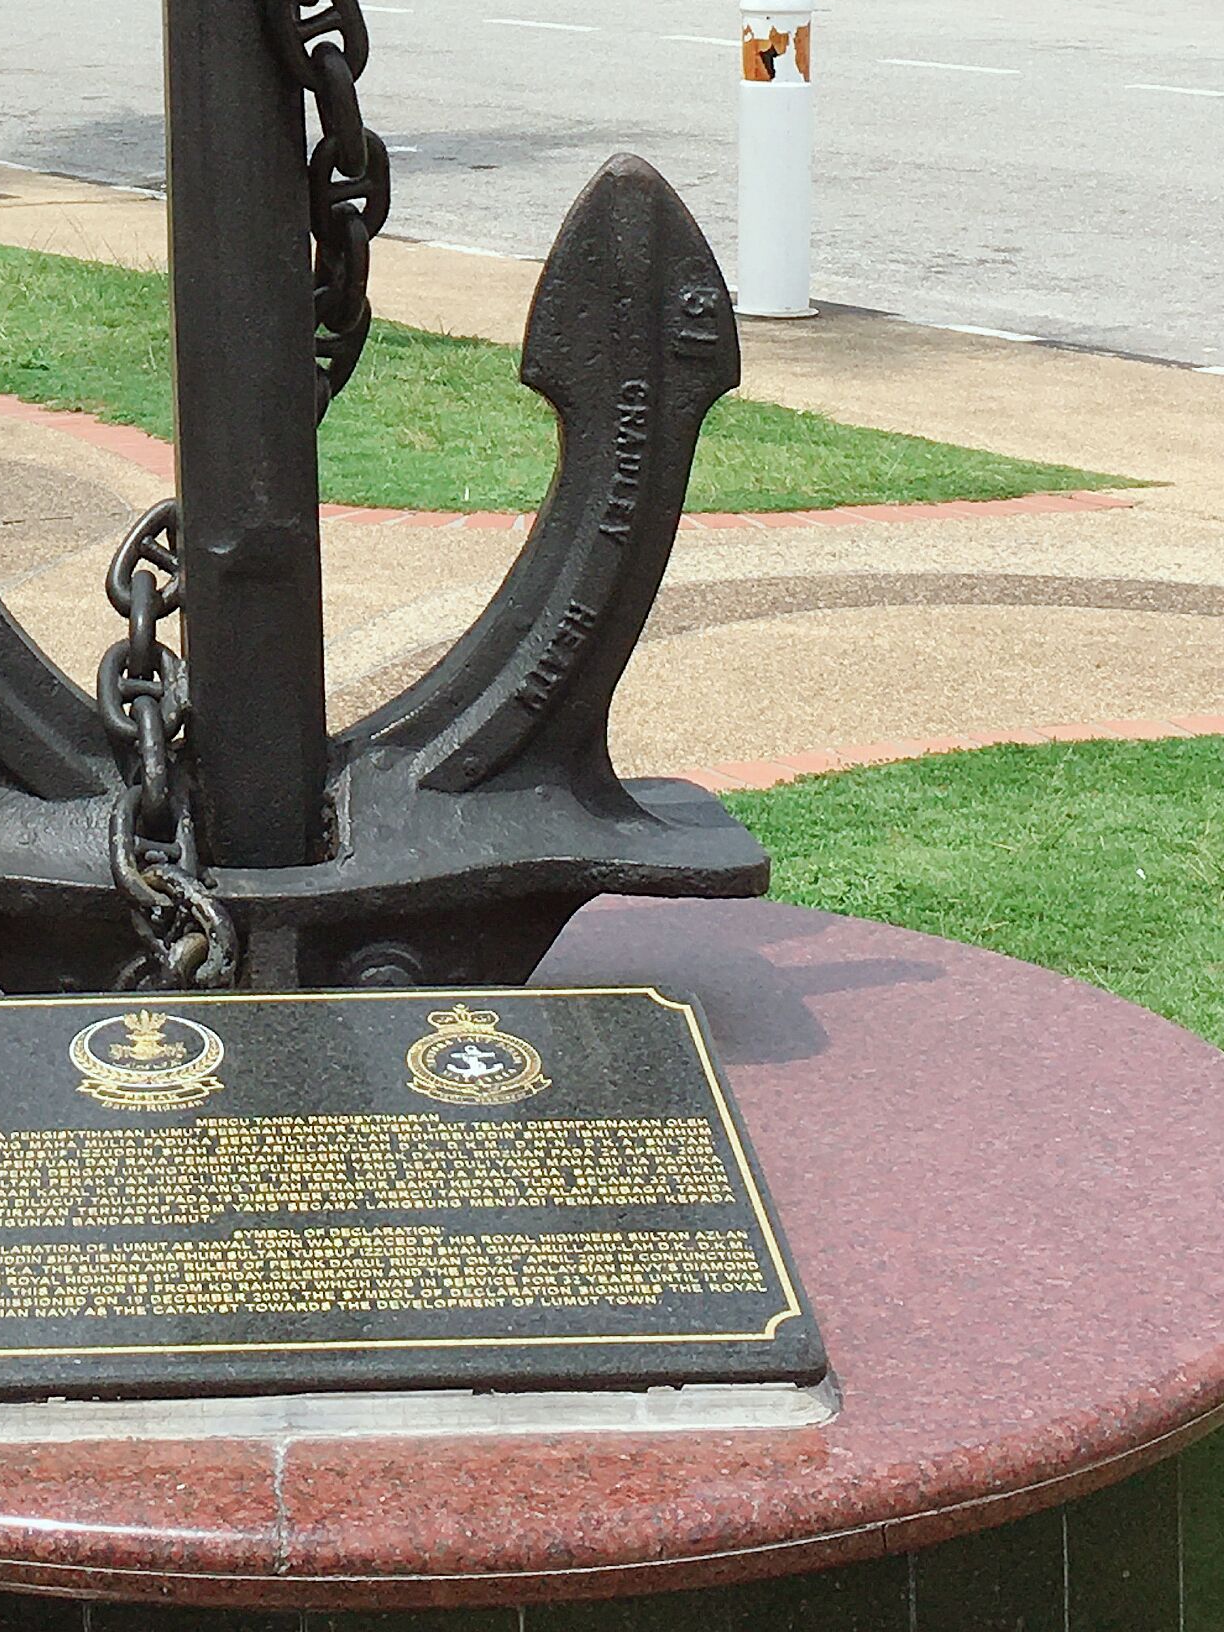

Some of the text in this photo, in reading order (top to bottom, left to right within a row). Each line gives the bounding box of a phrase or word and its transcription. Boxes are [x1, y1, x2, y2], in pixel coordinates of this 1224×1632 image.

[150, 1127, 202, 1137] LUMUT
[207, 1126, 276, 1135] SEBAGAI
[280, 1125, 346, 1134] BANDAR
[350, 1123, 422, 1132] TENTERA
[470, 1121, 522, 1130] TELAH
[195, 1117, 250, 1127] MERCU
[252, 1116, 304, 1125] TANDA
[84, 1139, 135, 1147] MULIA
[143, 1137, 211, 1146] PADUKA
[265, 1135, 328, 1144] SULTAN
[335, 1133, 390, 1142] AZLAN
[615, 1127, 712, 1137] ALMARHUM
[2, 1149, 67, 1159] YUSSUF
[76, 1147, 153, 1157] IZZUDDIN
[283, 1153, 344, 1162] NEGERI
[350, 1152, 406, 1161] PERAK
[411, 1150, 468, 1159] DARUL
[473, 1149, 545, 1158] RIDZUAN
[623, 1146, 672, 1155] APRIL
[48, 1167, 115, 1176] DENGAN
[598, 1156, 649, 1165] MULIA
[654, 1155, 722, 1164] PADUKA
[49, 1177, 105, 1186] PERAK
[212, 1173, 261, 1182] INTAN
[268, 1172, 346, 1181] TENTERA
[405, 1169, 467, 1179] DIRAJA
[654, 1164, 725, 1174] ADALAH
[14, 1197, 82, 1207] DILUCUT
[90, 1196, 158, 1205] TAULIAH
[238, 1192, 322, 1202] DISEMBER
[374, 1190, 432, 1199] MERCU
[438, 1188, 493, 1197] TANDA
[524, 1186, 592, 1196] ADALAH
[597, 1185, 671, 1194] SEBAGAI
[675, 1184, 732, 1193] TANDA
[36, 1187, 89, 1196] KAPAL
[124, 1185, 192, 1194] RAHMAT
[248, 1182, 301, 1191] TELAH
[307, 1181, 389, 1190] MENABUR
[394, 1179, 444, 1188] BAKTI
[449, 1178, 516, 1188] KEPADA
[575, 1176, 644, 1185] SELAMA
[672, 1174, 728, 1183] TAHUN
[77, 1205, 170, 1215] TERHADAP
[286, 1201, 358, 1211] SECARA
[365, 1199, 462, 1209] LANGSUNG
[469, 1197, 546, 1207] MENJADI
[664, 1193, 736, 1203] KEPADA
[72, 1216, 144, 1226] BANDAR
[151, 1214, 214, 1224] LUMUT.
[113, 1241, 168, 1252] LUMUT
[198, 1240, 250, 1250] NAVAL
[347, 1236, 417, 1246] GRACED
[479, 1234, 535, 1243] ROYAL
[538, 1232, 623, 1242] HIGHNESS
[626, 1231, 691, 1241] SULTAN
[692, 1230, 748, 1240] AZLAN
[232, 1229, 300, 1239] SYMBOL
[78, 1263, 140, 1273] SULTAN
[183, 1261, 238, 1271] RULER
[269, 1259, 325, 1269] PERAK
[329, 1258, 385, 1268] DARUL
[389, 1256, 461, 1266] RIDZUAN
[525, 1254, 574, 1263] APRIL
[130, 1251, 222, 1261] ALMARHUM
[226, 1249, 288, 1260] SULTAN
[291, 1248, 355, 1258] YUSSUF
[359, 1246, 432, 1256] IZZUDDIN
[7, 1276, 60, 1285] ROYAL
[65, 1274, 147, 1284] HIGHNESS
[184, 1271, 265, 1281] BIRTHDAY
[463, 1266, 518, 1275] ROYAL
[619, 1262, 679, 1272] NAVY'S
[681, 1261, 759, 1271] DIAMOND
[54, 1285, 125, 1295] ANCHOR
[238, 1281, 307, 1290] RAHMAT
[313, 1279, 370, 1289] WHICH
[442, 1276, 516, 1286] SERVICE
[585, 1274, 643, 1283] YEARS
[648, 1272, 699, 1282] UNTIL
[150, 1292, 246, 1304] DECEMBER
[341, 1288, 414, 1299] SYMBOL
[708, 1282, 767, 1292] ROYAL
[35, 1307, 80, 1317] NAVY
[152, 1303, 239, 1314] CATALYST
[244, 1301, 331, 1312] TOWARDS
[540, 1296, 601, 1306] LUMUT
[604, 1295, 662, 1304] TOWN.
